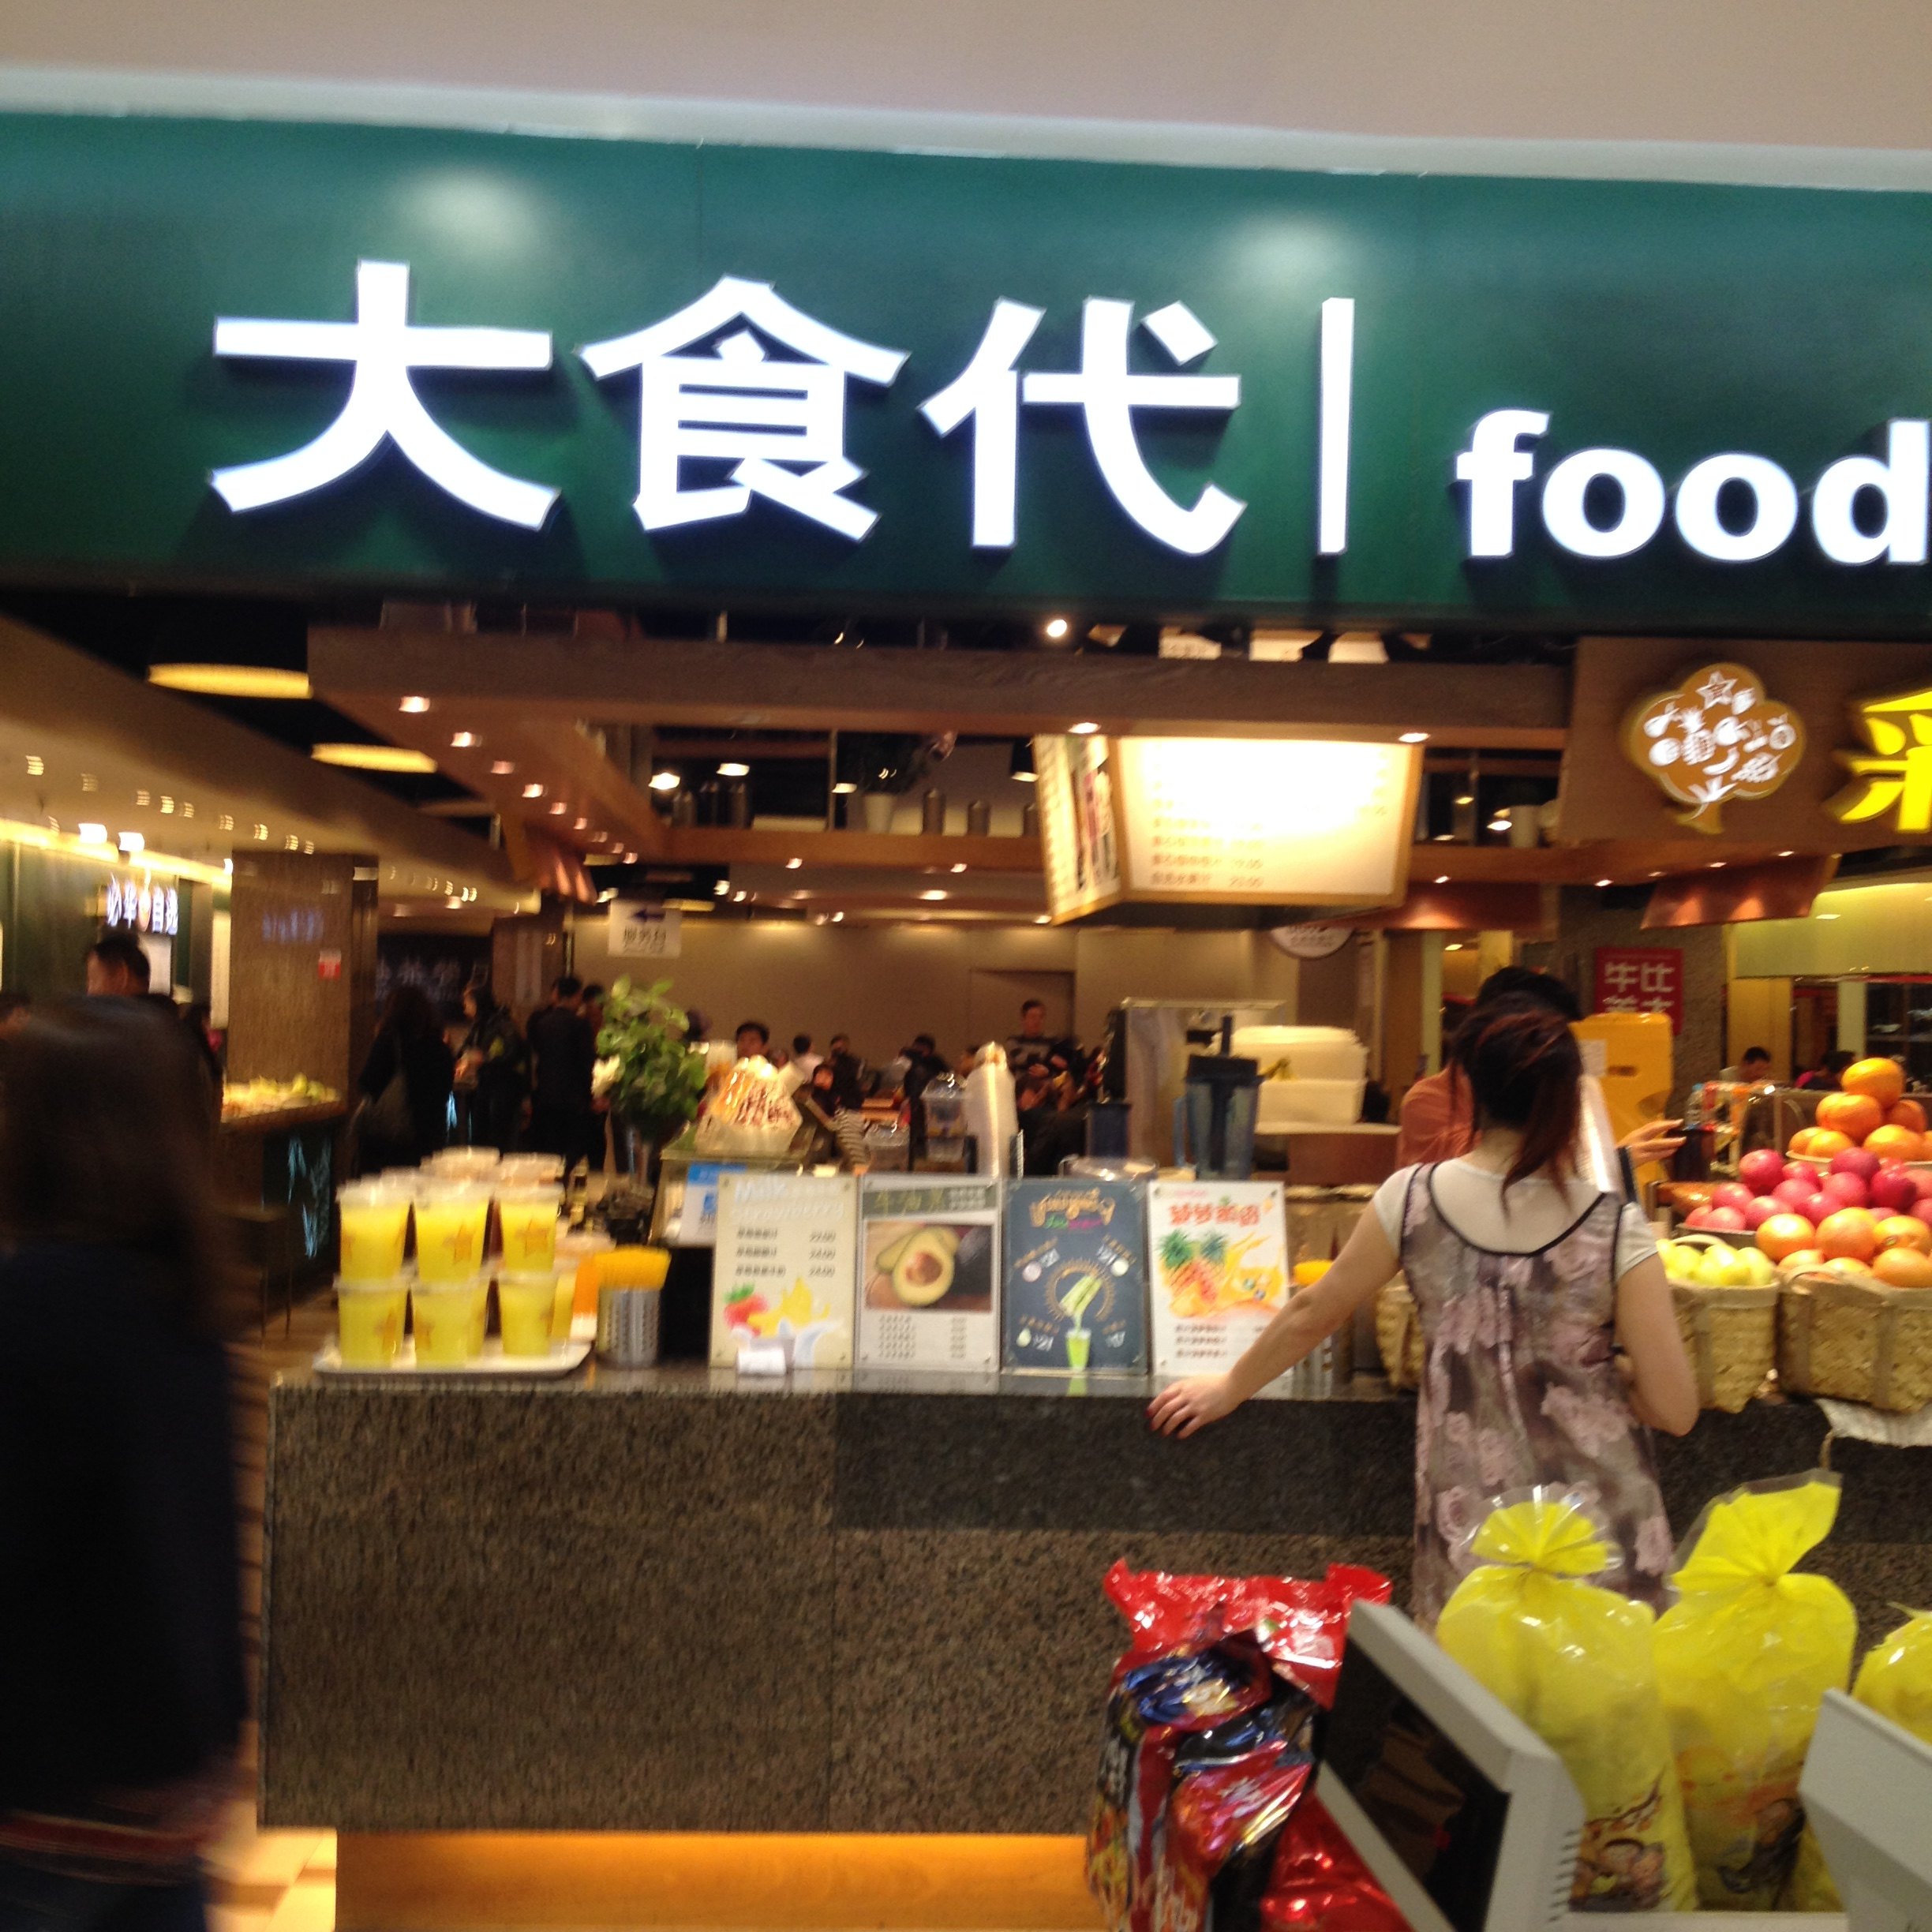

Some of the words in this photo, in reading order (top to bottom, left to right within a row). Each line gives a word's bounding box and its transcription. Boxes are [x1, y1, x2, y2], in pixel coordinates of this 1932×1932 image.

[210, 260, 1248, 556] 大食代
[1455, 407, 1930, 566] food
